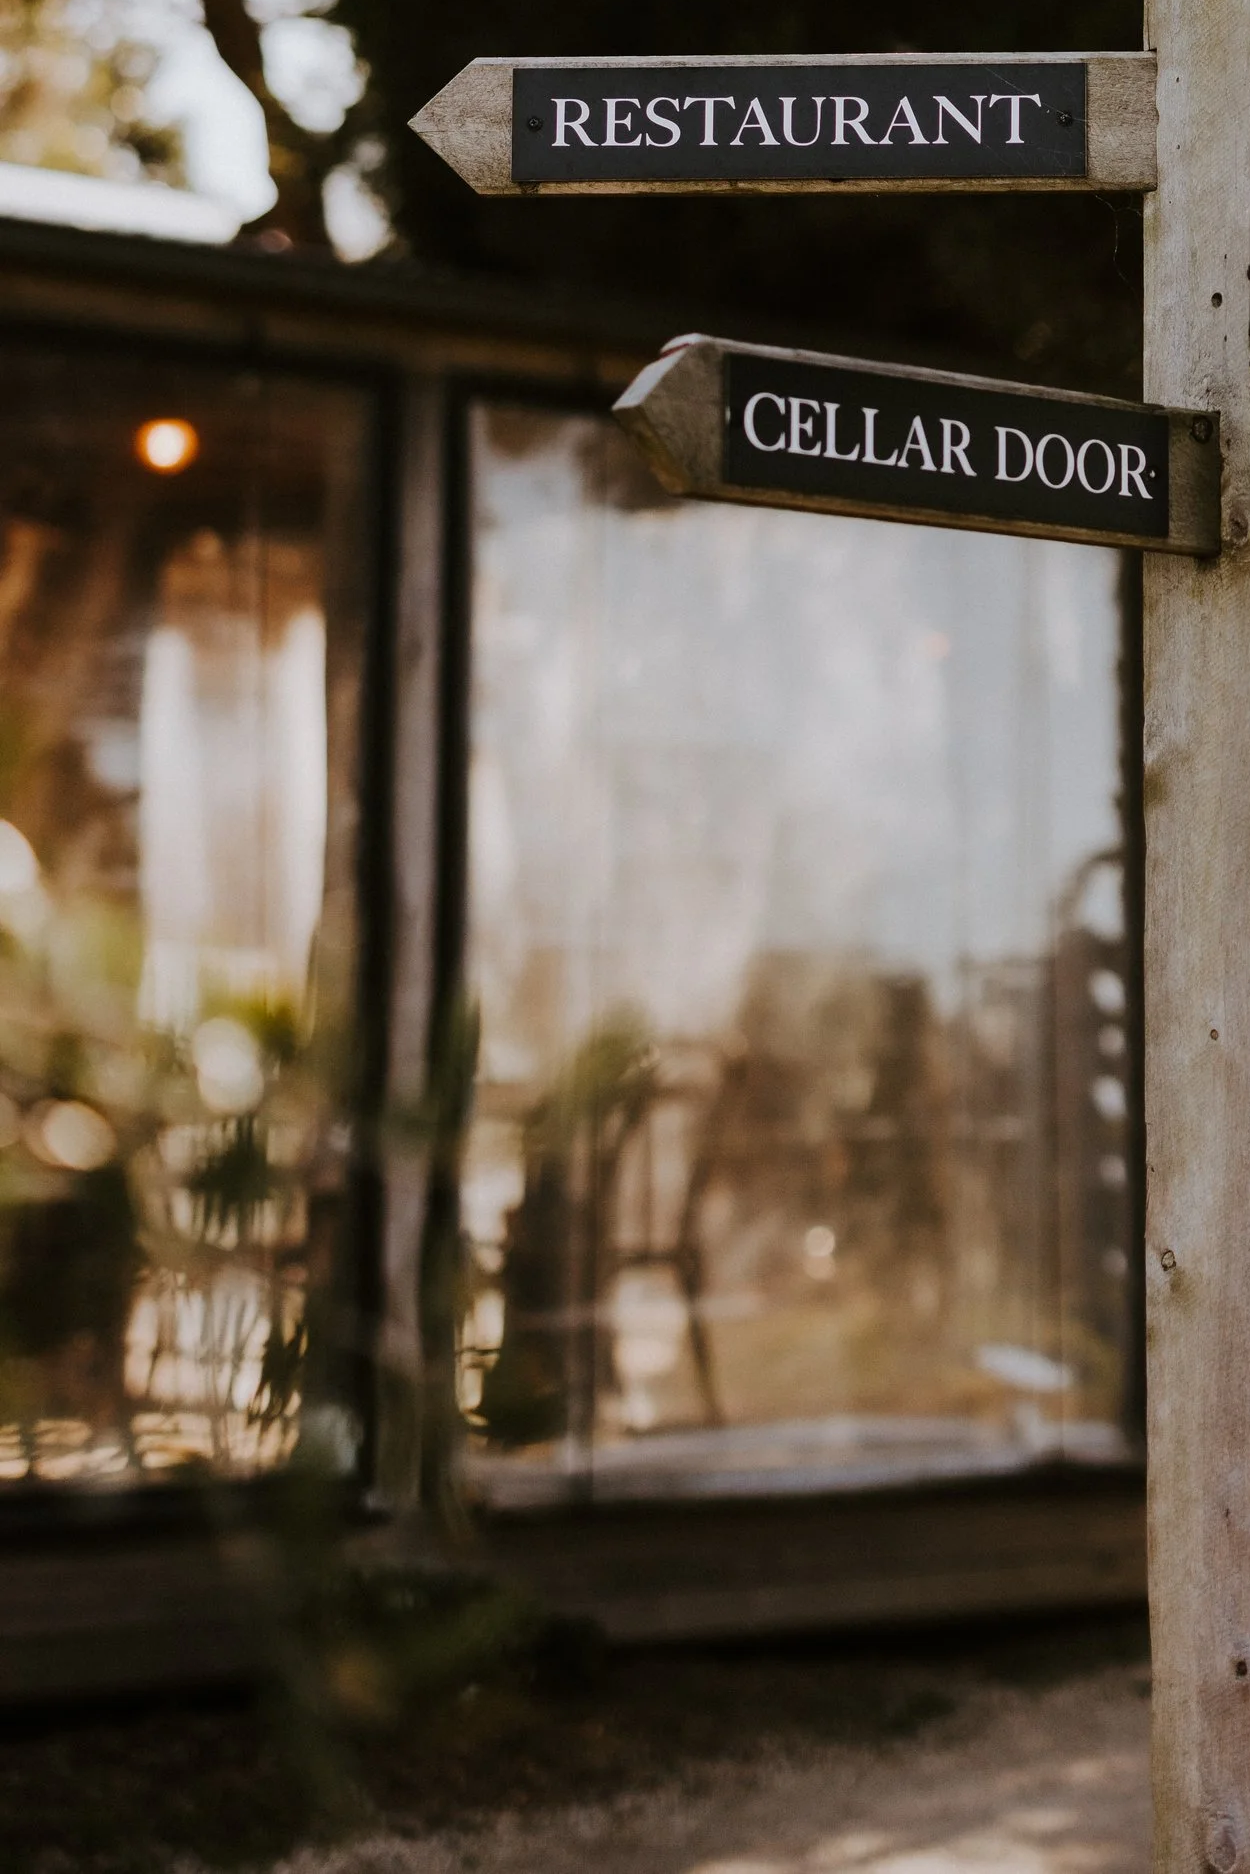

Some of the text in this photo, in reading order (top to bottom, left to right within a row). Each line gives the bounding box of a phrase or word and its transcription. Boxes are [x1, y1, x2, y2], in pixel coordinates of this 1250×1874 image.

[551, 94, 1041, 147] RESTAURANT
[743, 392, 1153, 499] CELLAR DOOR
